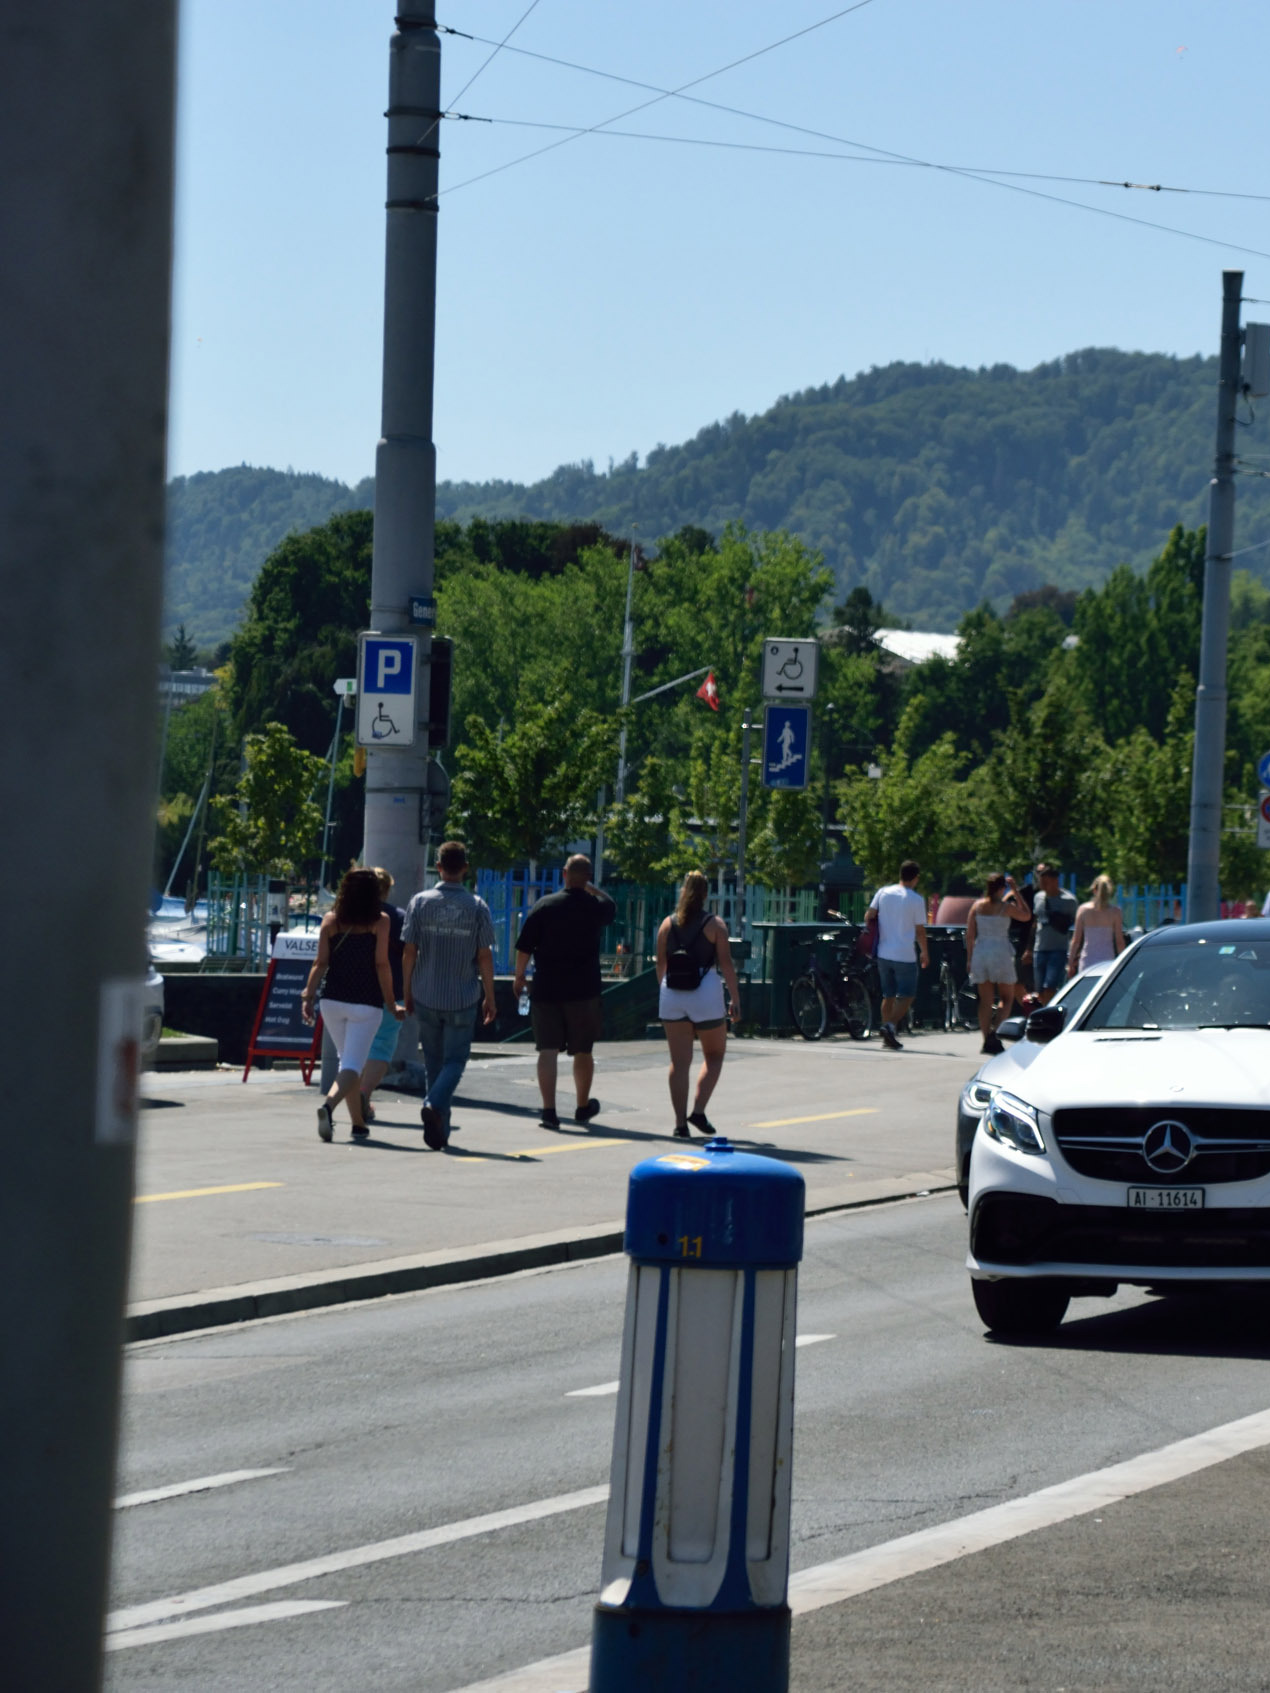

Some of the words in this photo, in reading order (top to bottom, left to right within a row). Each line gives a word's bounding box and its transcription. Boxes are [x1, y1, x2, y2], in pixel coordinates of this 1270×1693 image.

[377, 649, 402, 688] P
[285, 939, 318, 952] VALSE
[1157, 1192, 1198, 1207] 11614
